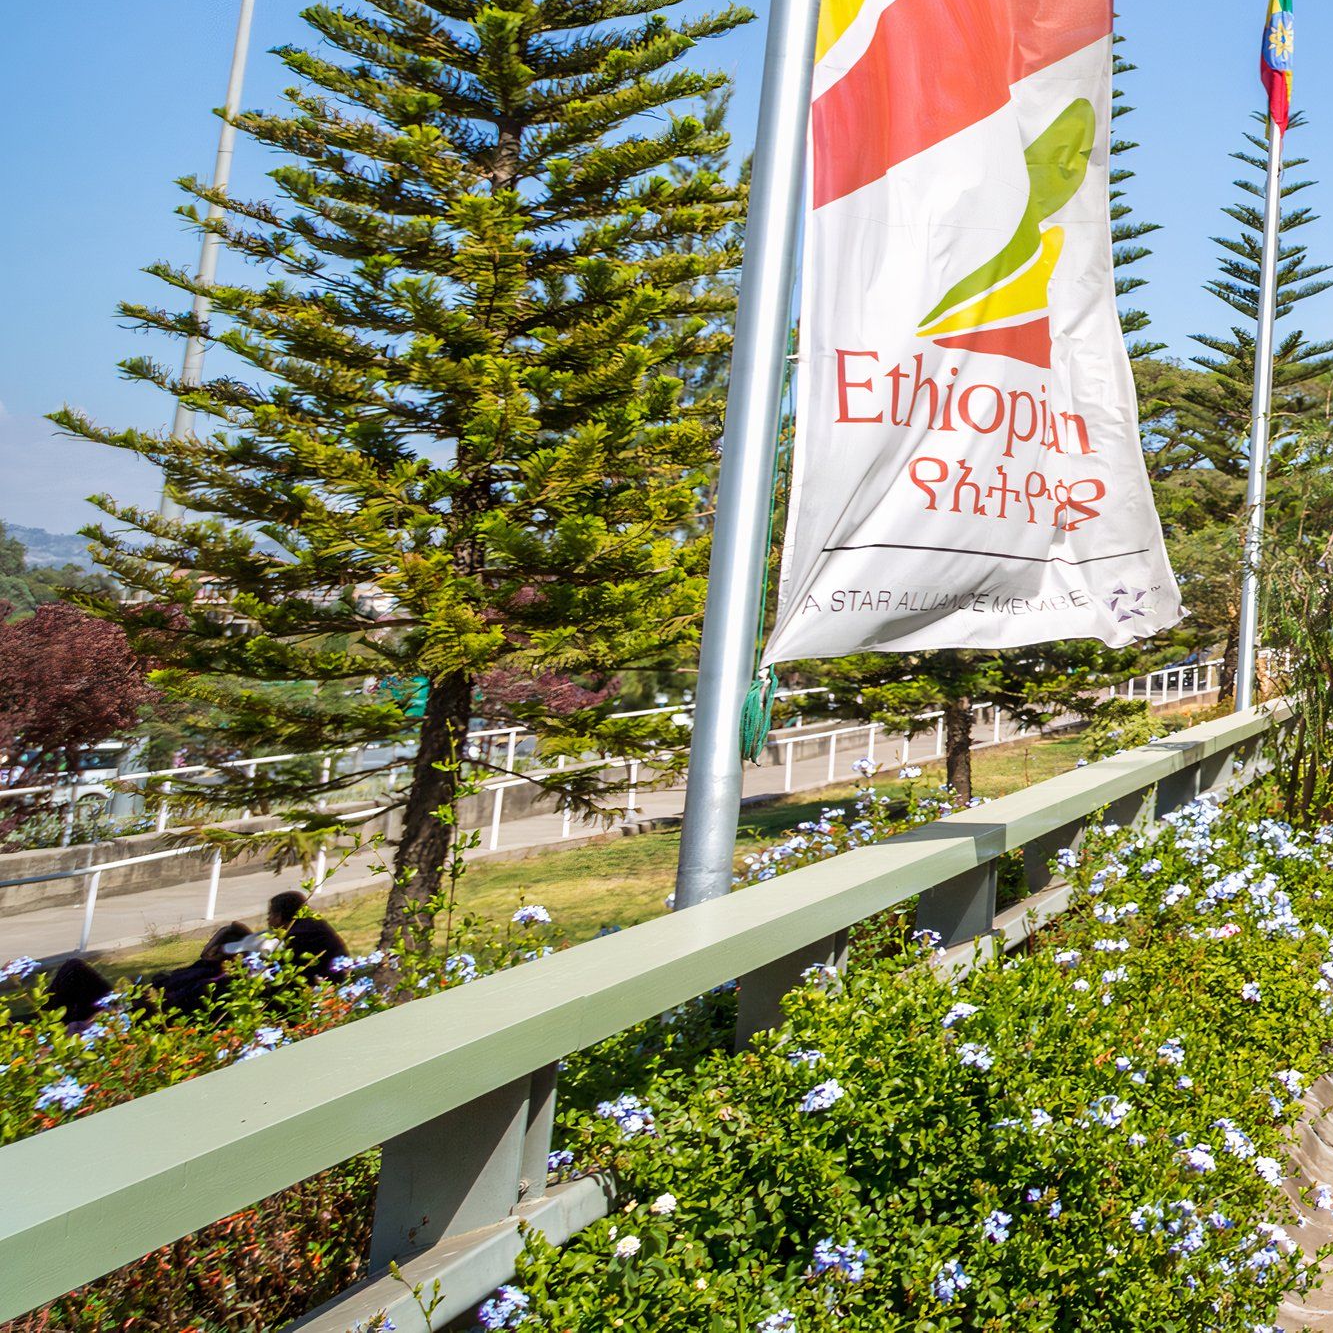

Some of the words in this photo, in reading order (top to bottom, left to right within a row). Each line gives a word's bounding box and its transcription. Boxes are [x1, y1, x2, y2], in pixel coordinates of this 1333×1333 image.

[834, 348, 1099, 458] Ethiopian
[801, 594, 822, 614] A
[830, 590, 892, 613] STAR
[895, 591, 990, 613] ALLIANCE
